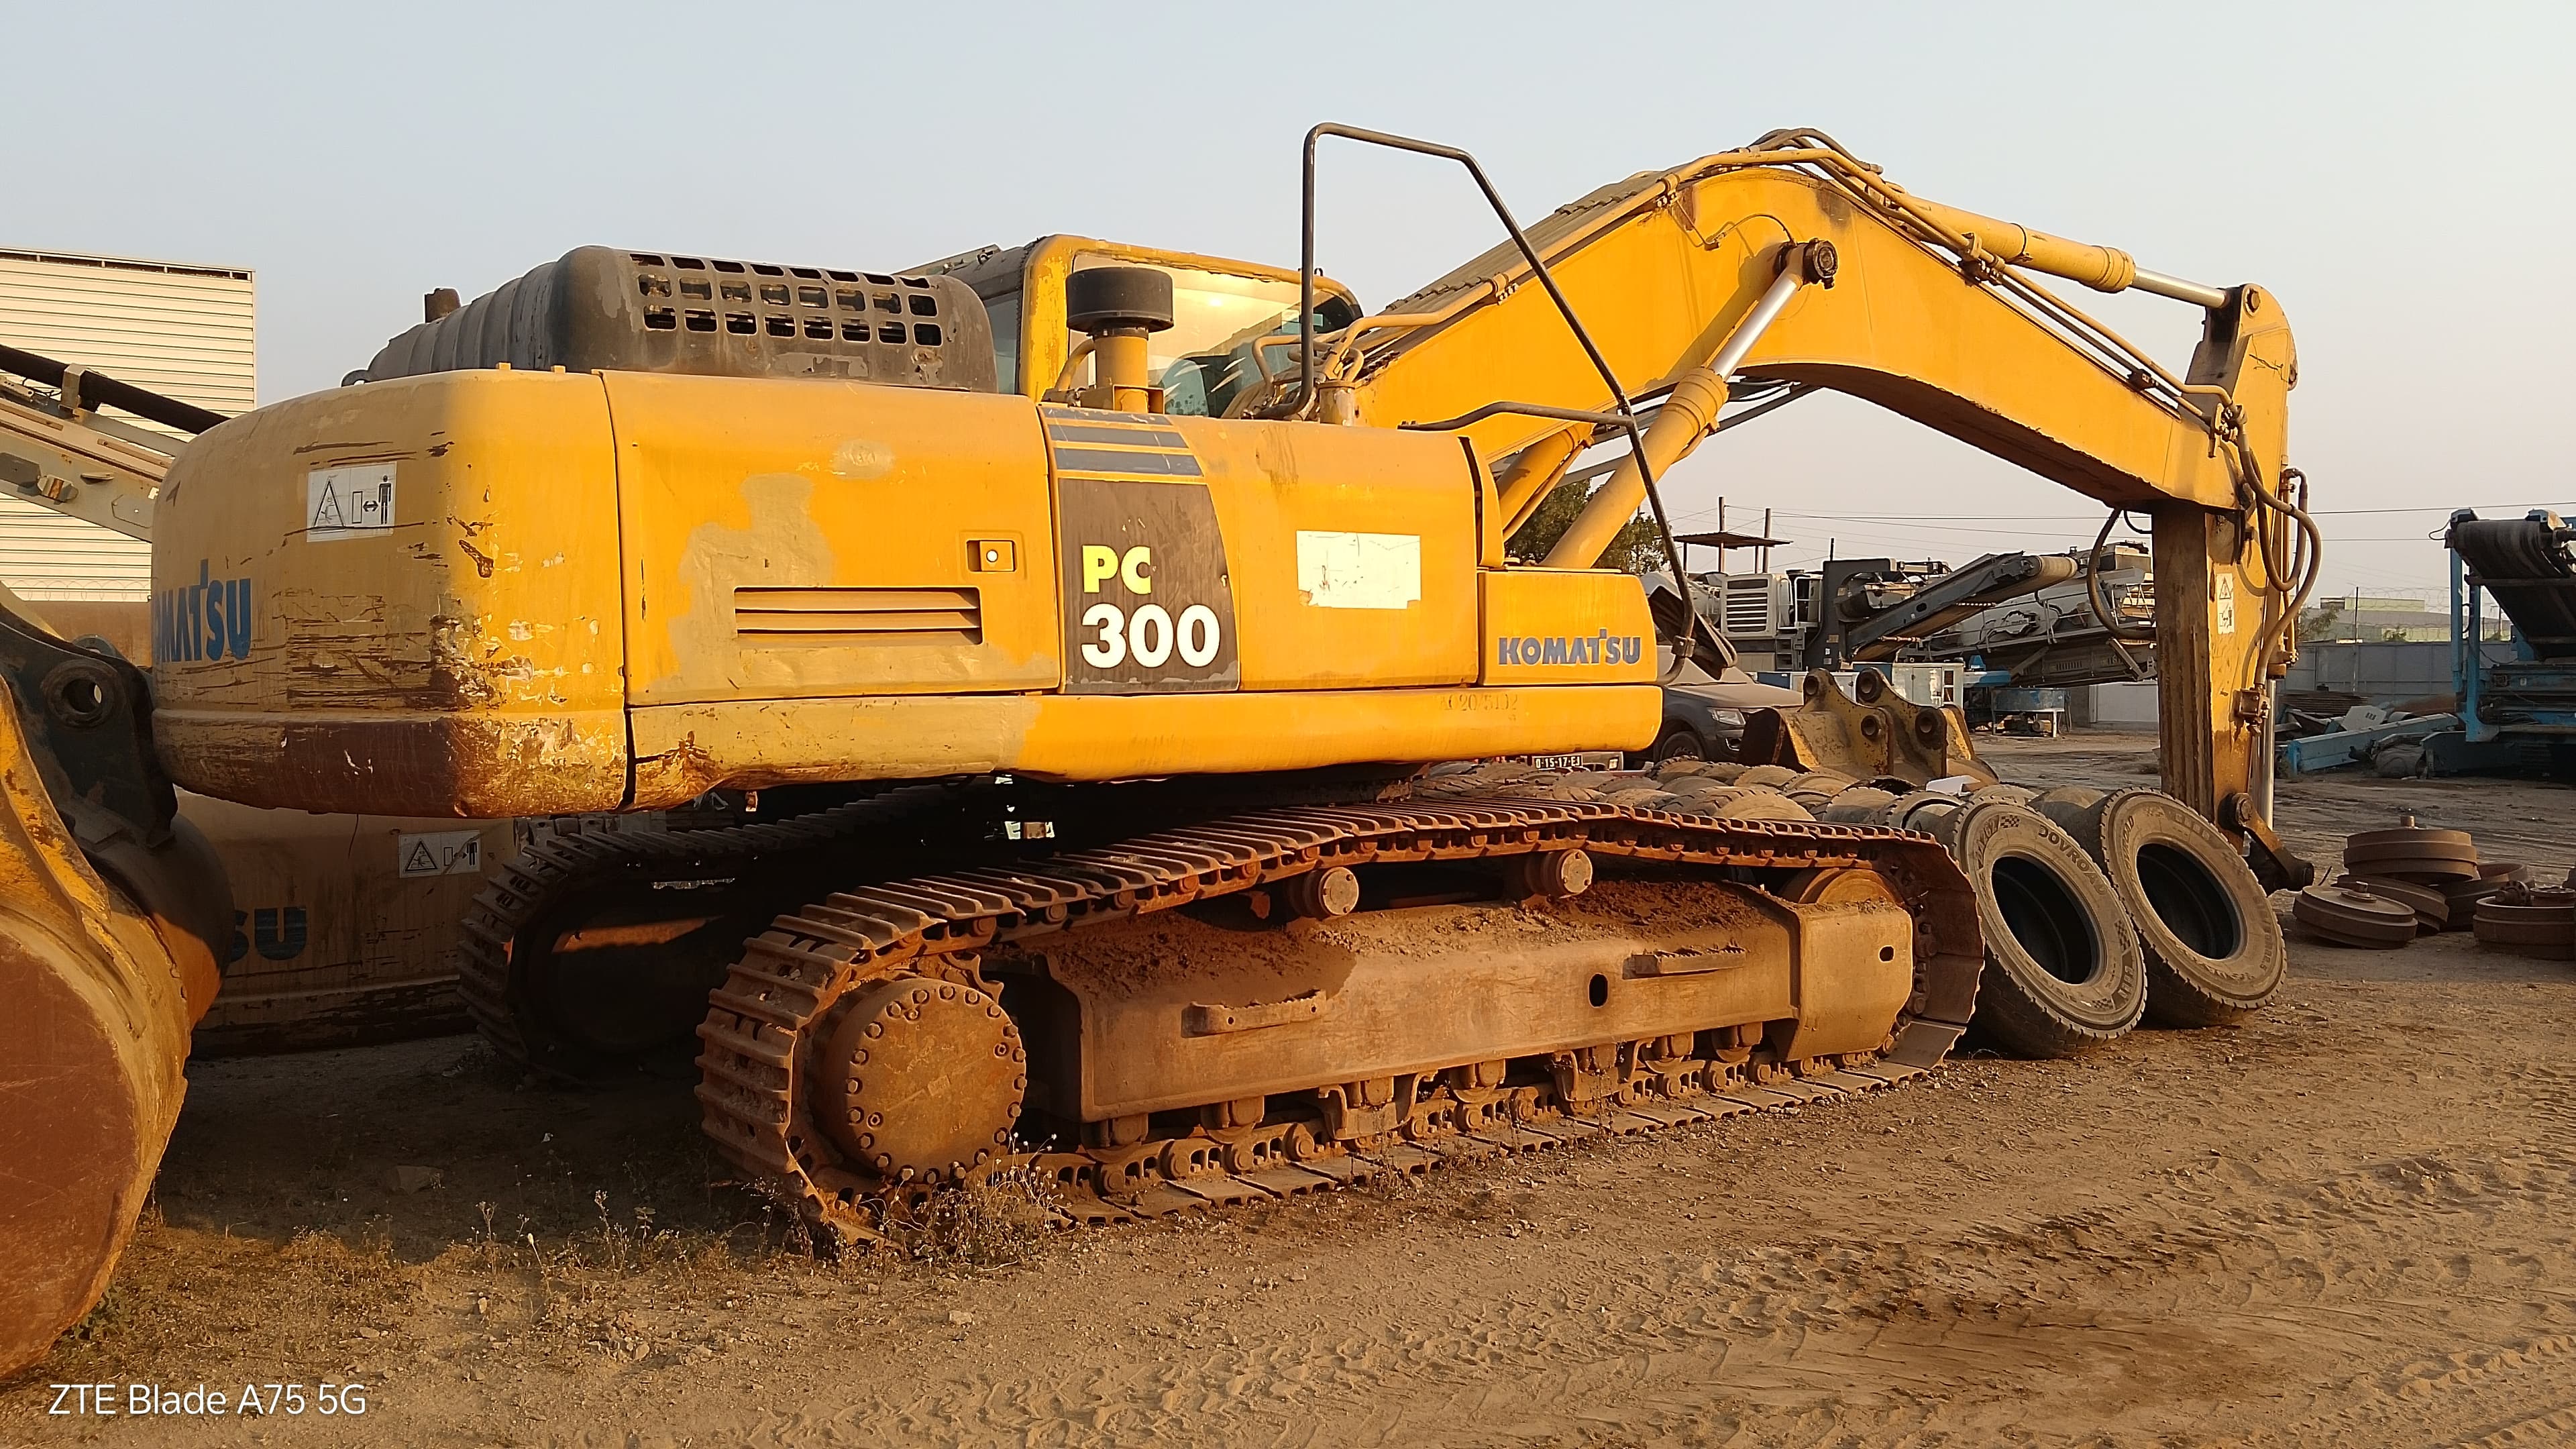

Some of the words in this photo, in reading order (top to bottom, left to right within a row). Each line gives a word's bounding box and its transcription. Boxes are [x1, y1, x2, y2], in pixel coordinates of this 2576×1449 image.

[1081, 544, 1152, 595] PC
[1081, 602, 1220, 669] 300
[1498, 628, 1641, 665] KOMATSU
